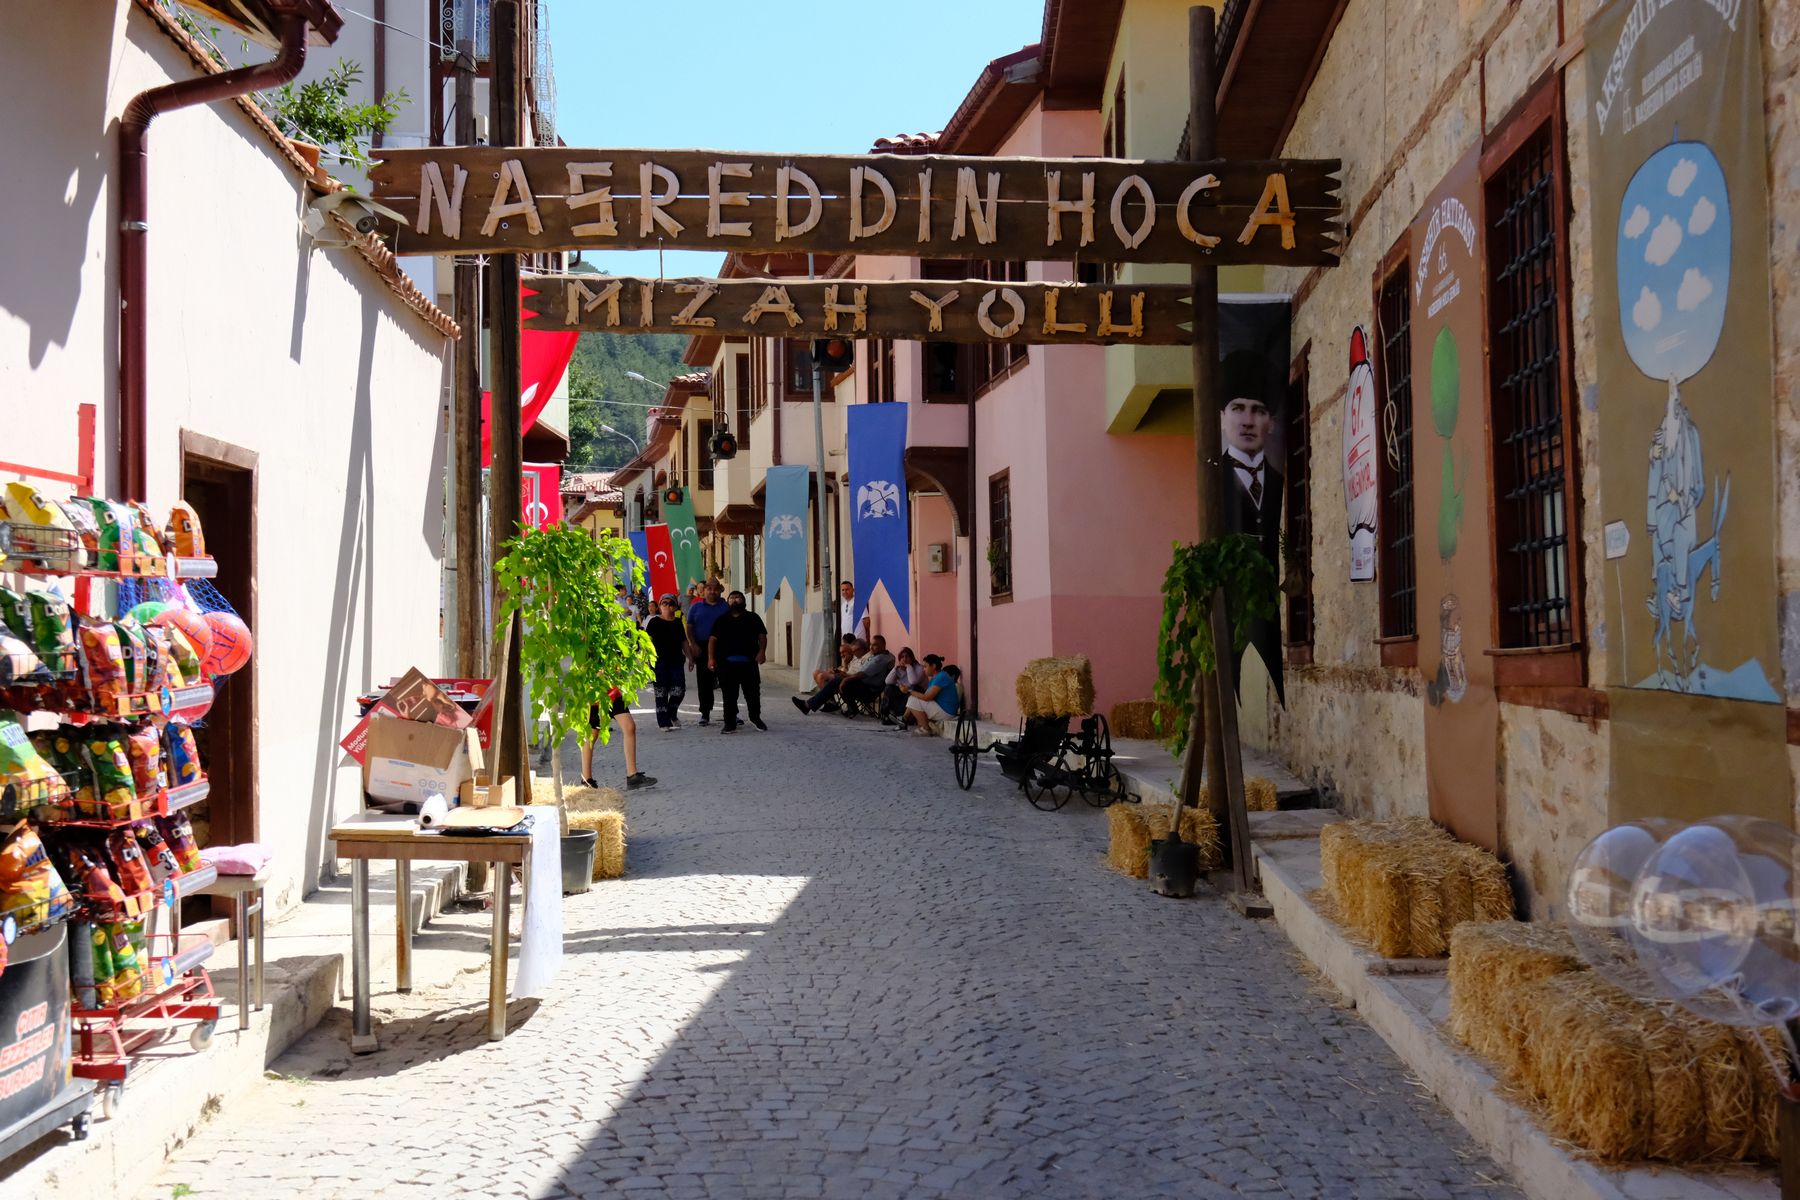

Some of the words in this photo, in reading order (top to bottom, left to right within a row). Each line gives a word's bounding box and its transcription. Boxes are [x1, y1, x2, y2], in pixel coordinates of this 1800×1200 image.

[416, 159, 1000, 244] NASREDDIN
[1047, 170, 1296, 250] HOCA
[565, 279, 869, 332] MIZAH
[909, 287, 1145, 338] YOLU
[0, 1023, 54, 1073] EZZETLER
